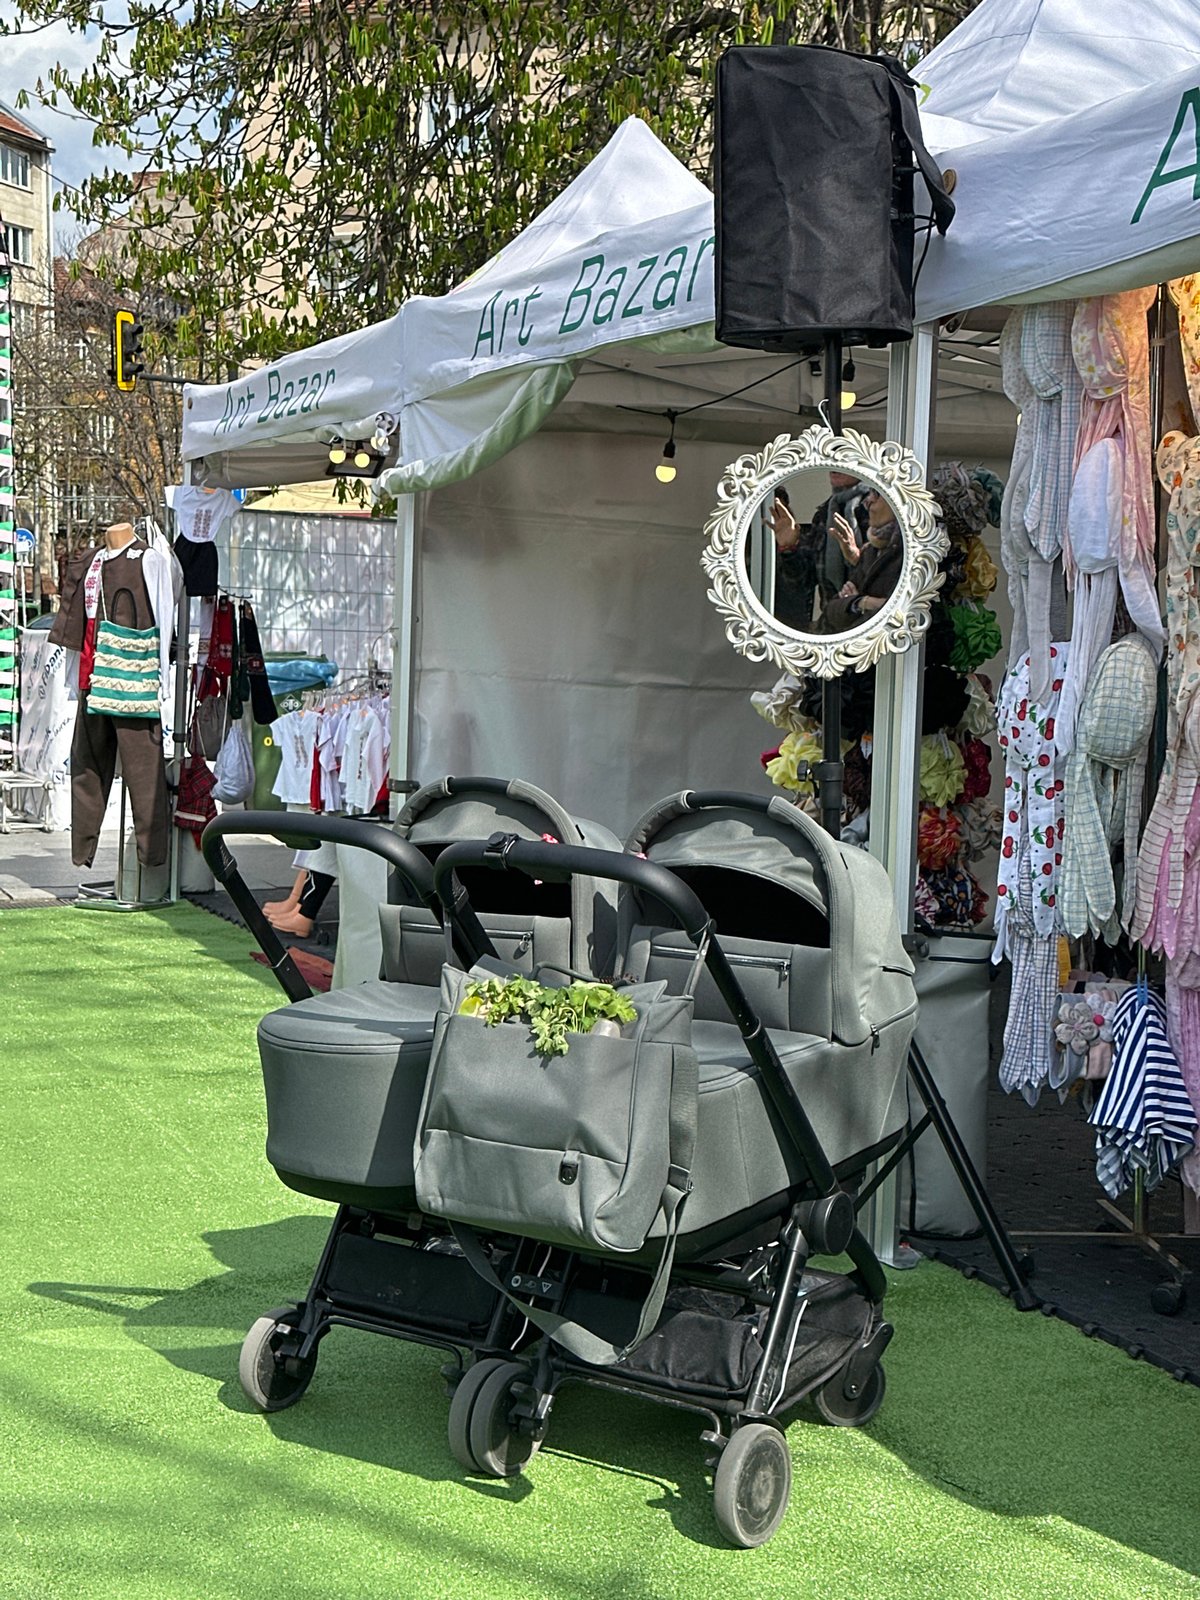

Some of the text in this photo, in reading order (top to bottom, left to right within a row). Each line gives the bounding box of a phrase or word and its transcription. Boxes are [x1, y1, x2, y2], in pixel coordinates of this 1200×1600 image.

[471, 236, 715, 360] Art Bazar
[213, 368, 336, 436] Art Bazar
